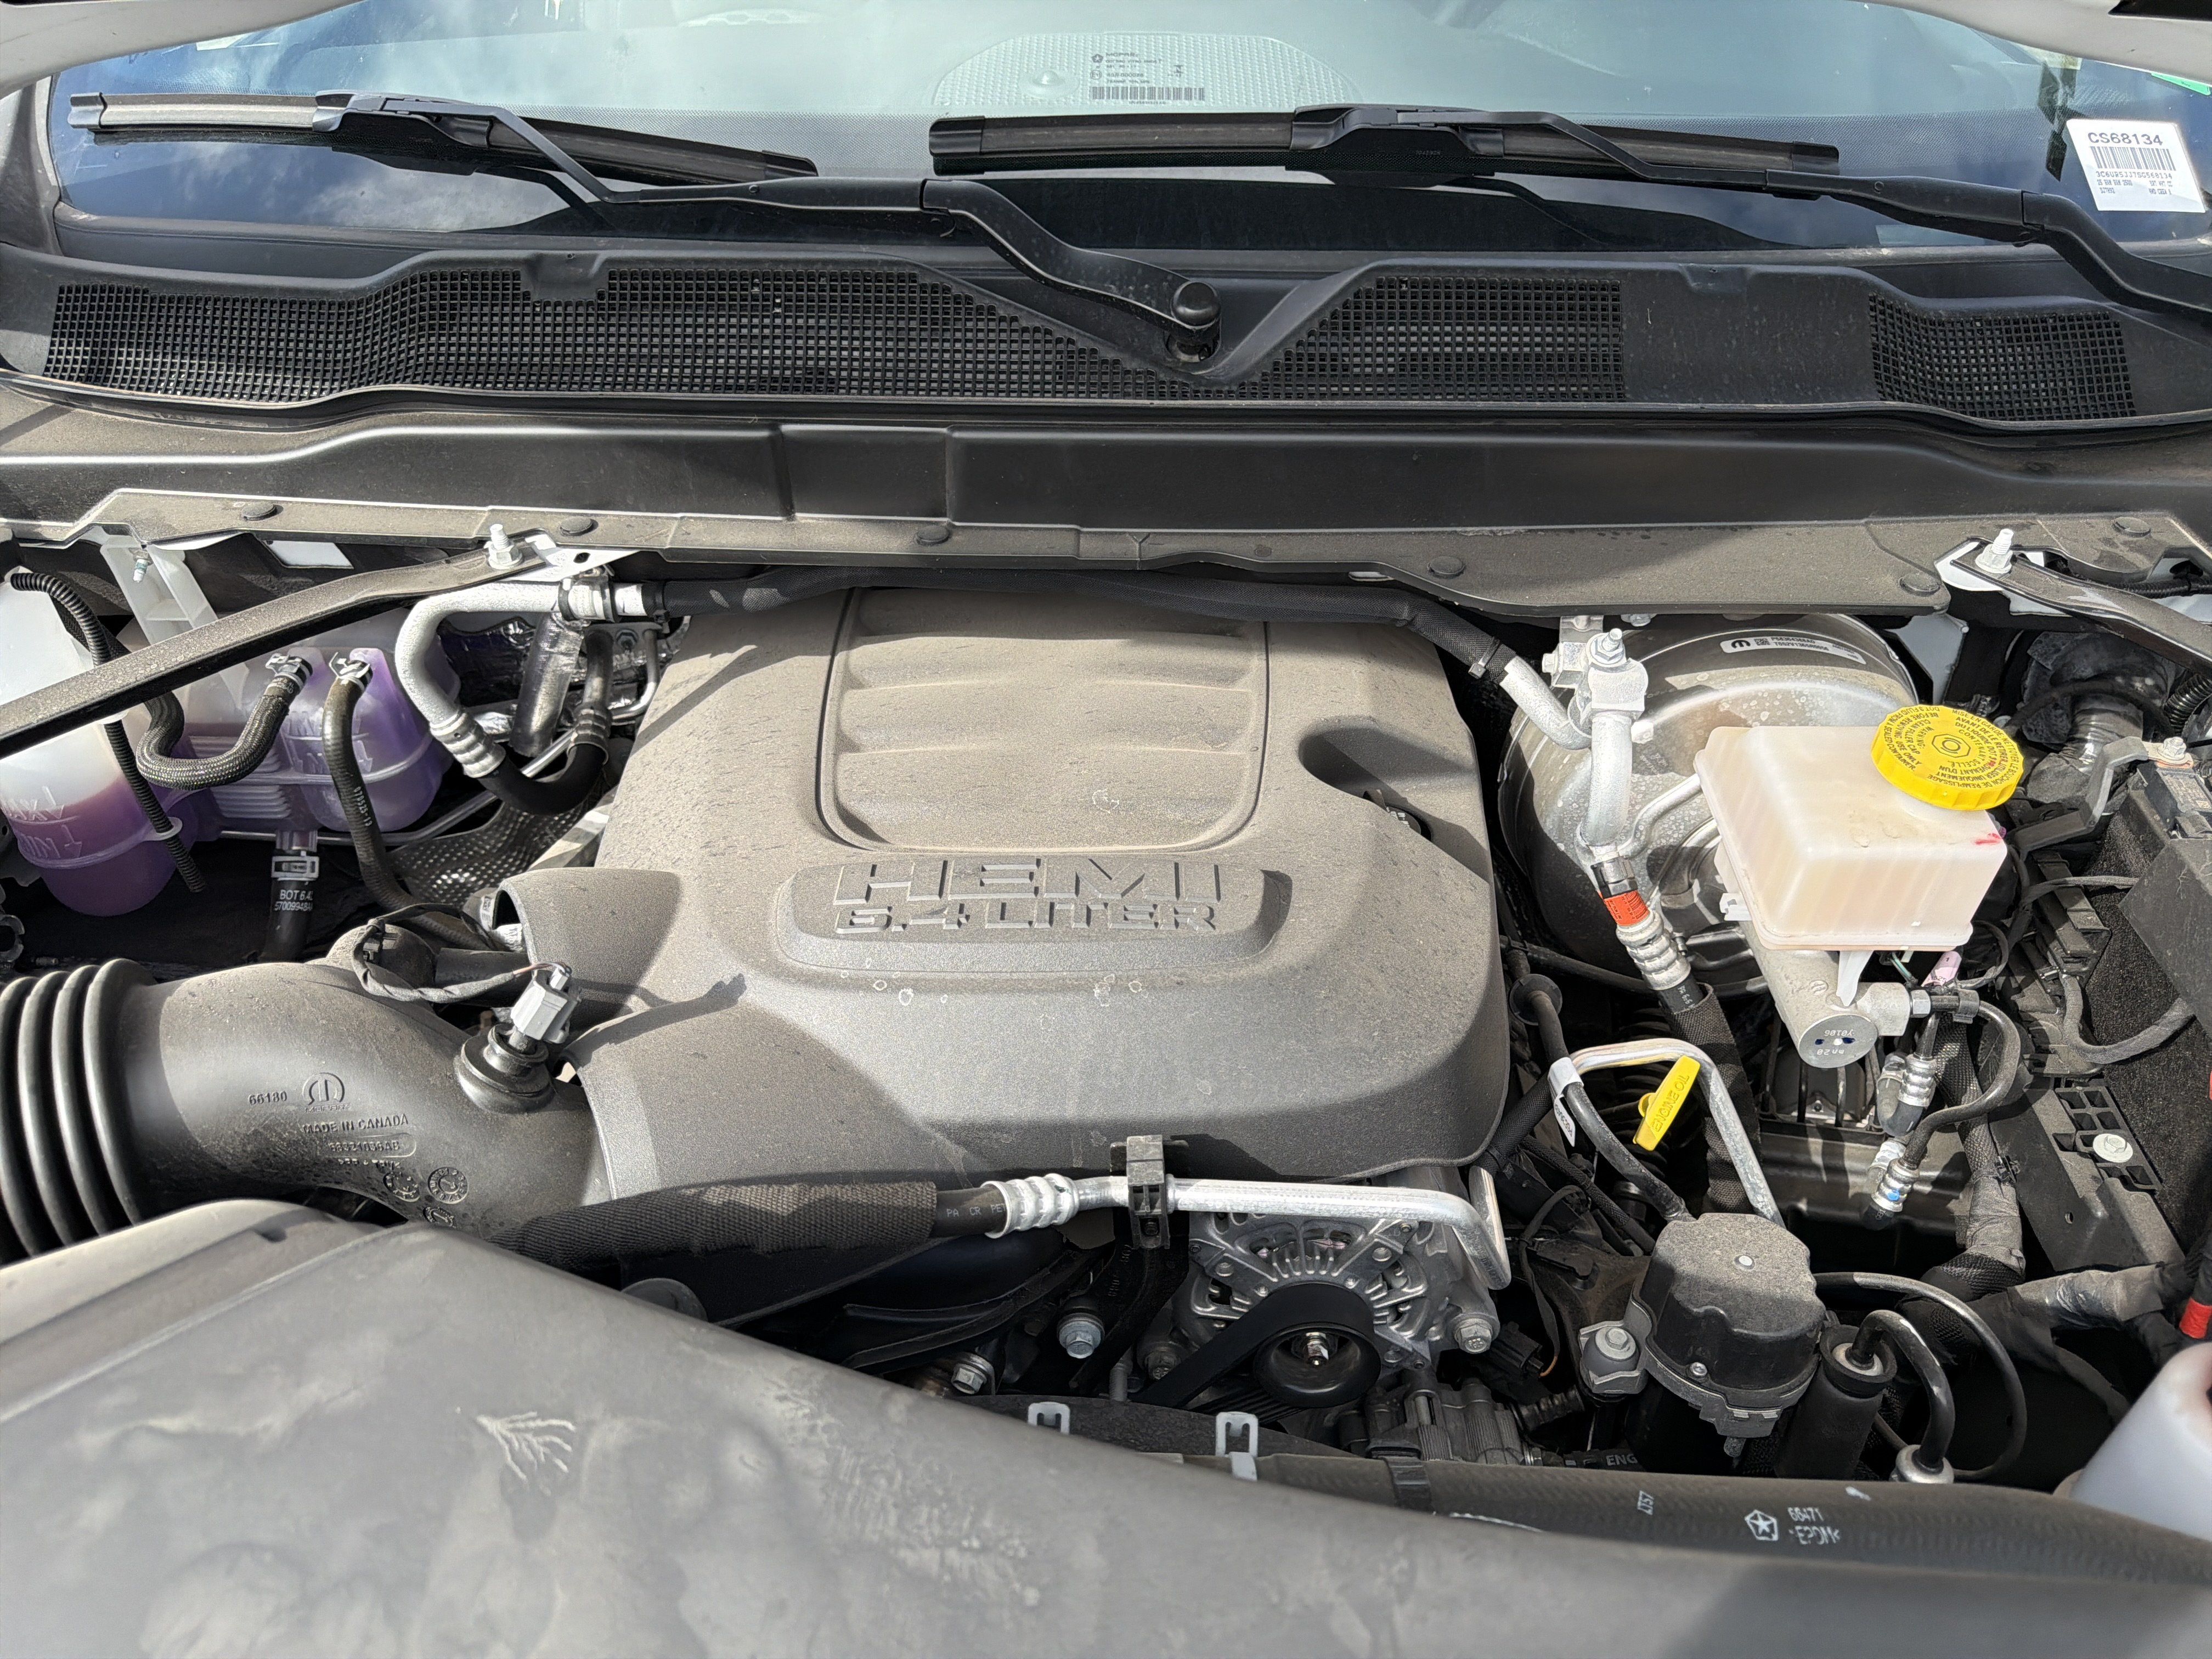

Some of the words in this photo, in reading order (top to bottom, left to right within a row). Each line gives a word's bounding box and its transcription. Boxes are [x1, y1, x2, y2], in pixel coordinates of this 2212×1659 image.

[2087, 132, 2163, 145] CS68134
[1901, 707, 1919, 715] FLUID
[1910, 712, 1939, 721] BEFORE
[1952, 709, 1969, 718] MISE
[1889, 713, 1904, 724] FROM
[1911, 719, 1931, 729] CLEAN
[1955, 716, 1982, 729] AVANT
[1883, 725, 1893, 743] SEALED
[1905, 727, 1916, 743] FILLER
[1916, 726, 1935, 749] WARNING:
[1966, 726, 1993, 746] LIQUIDE
[1895, 741, 1908, 751] USE
[1907, 744, 1921, 755] CAP
[1958, 729, 1987, 762] CONTENANT
[1986, 745, 1997, 757] DOT
[2001, 737, 2019, 763] NETTOYER
[1903, 752, 1922, 765] ONLY
[1936, 770, 1987, 782] UNIQUEMENT
[1939, 765, 1958, 775] D'UN
[1926, 774, 1982, 789] REMPLISSAGE
[1991, 768, 2017, 787] BOUCHON
[833, 858, 1222, 905] HEMI
[279, 889, 298, 900] BOT
[834, 902, 971, 933] 6.4
[984, 901, 1216, 932] LITER
[1651, 1090, 1680, 1132] ENGINE
[1674, 1075, 1690, 1092] OIL
[302, 1121, 338, 1134] MADE
[342, 1119, 355, 1131] IN
[358, 1113, 409, 1130] CANADA
[946, 1208, 960, 1217] PA
[969, 1206, 981, 1216] CR
[1606, 1453, 1638, 1466] ENG
